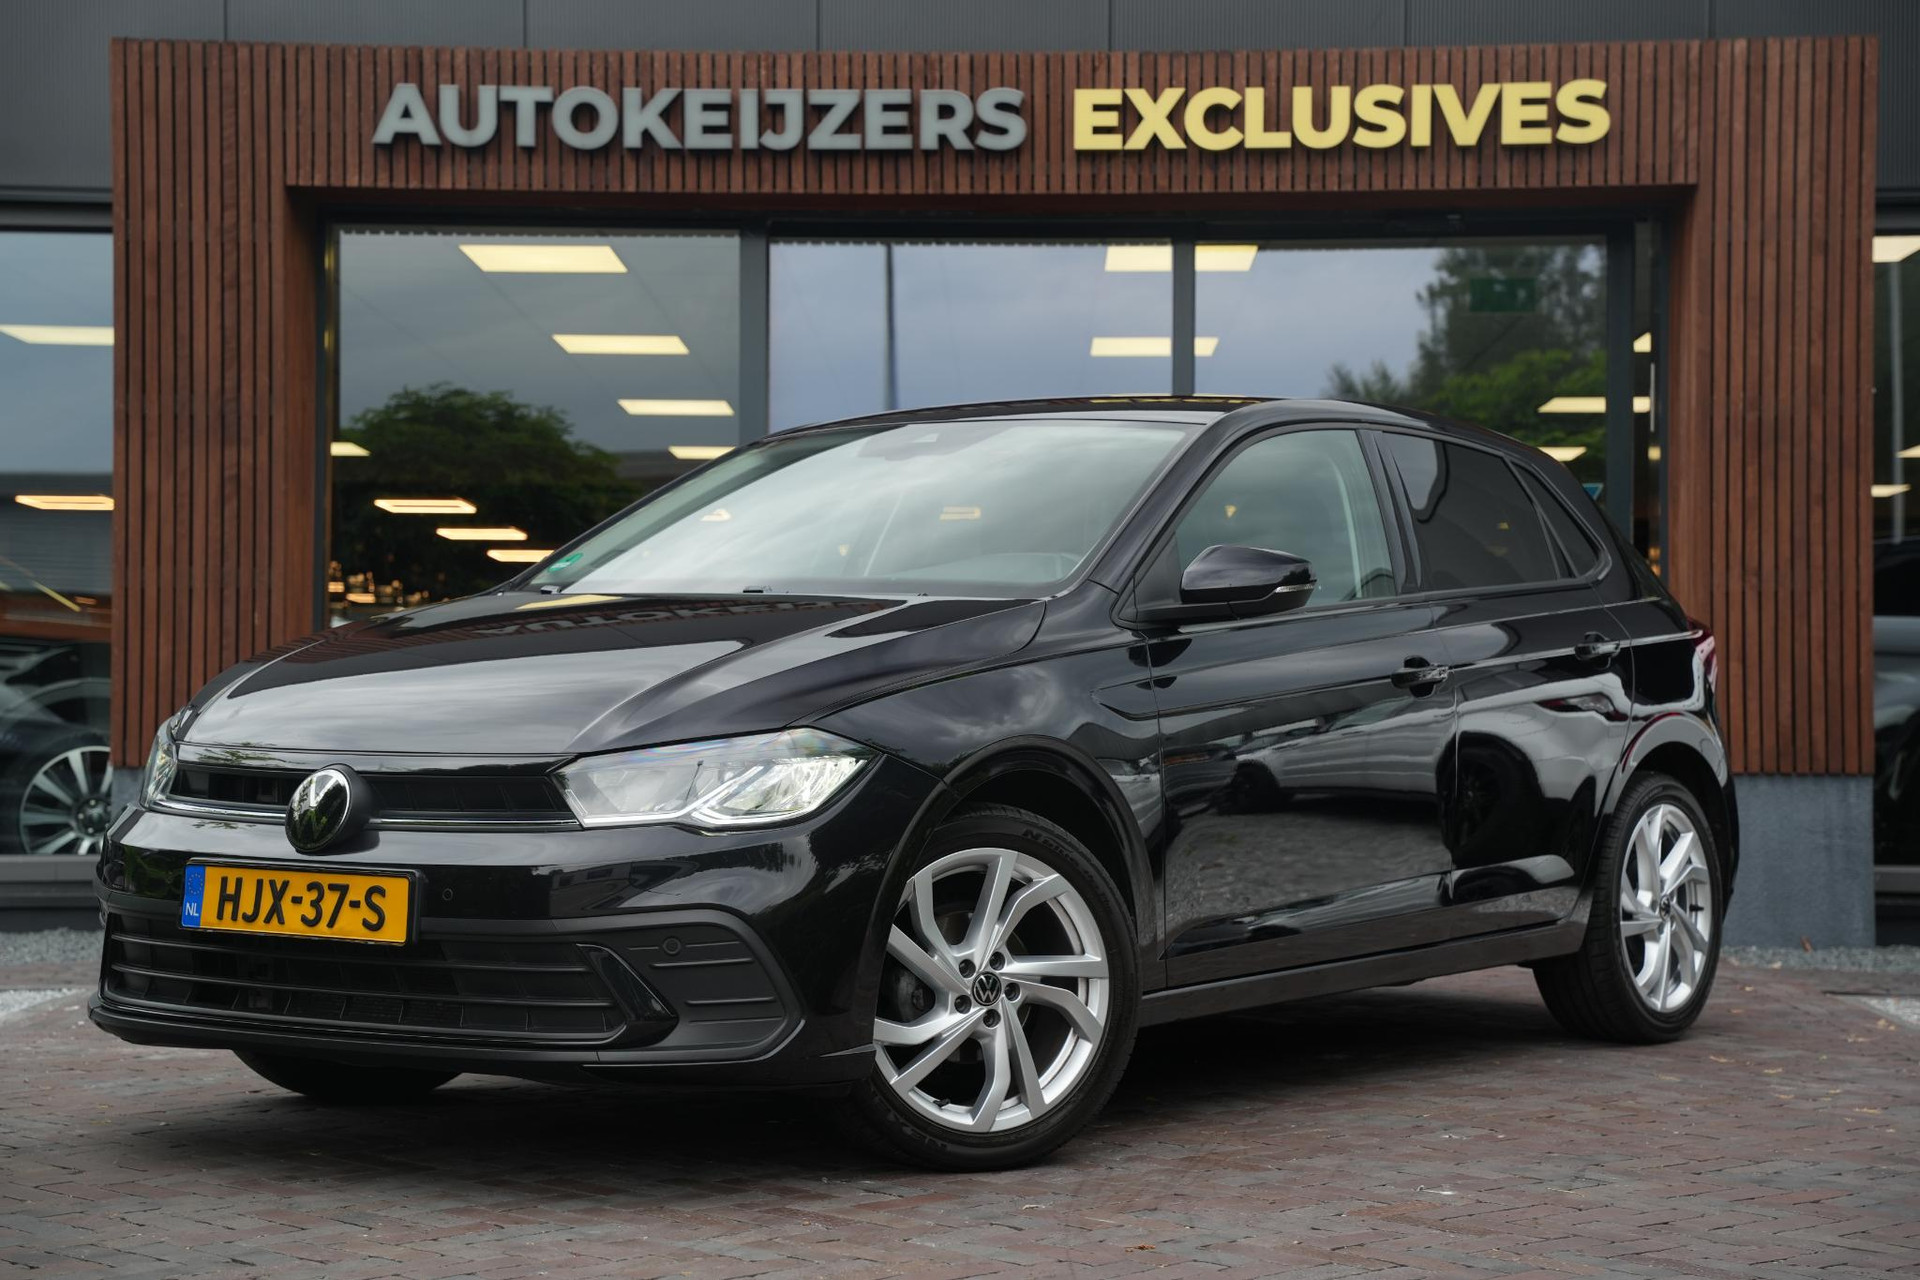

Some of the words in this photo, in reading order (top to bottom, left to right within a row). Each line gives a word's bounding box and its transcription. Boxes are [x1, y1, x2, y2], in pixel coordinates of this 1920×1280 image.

[371, 82, 1028, 150] AUTOKEIJZERS
[1073, 78, 1612, 151] EXCLUSIVES
[185, 902, 200, 917] NL
[216, 875, 387, 932] HJX-37-S
